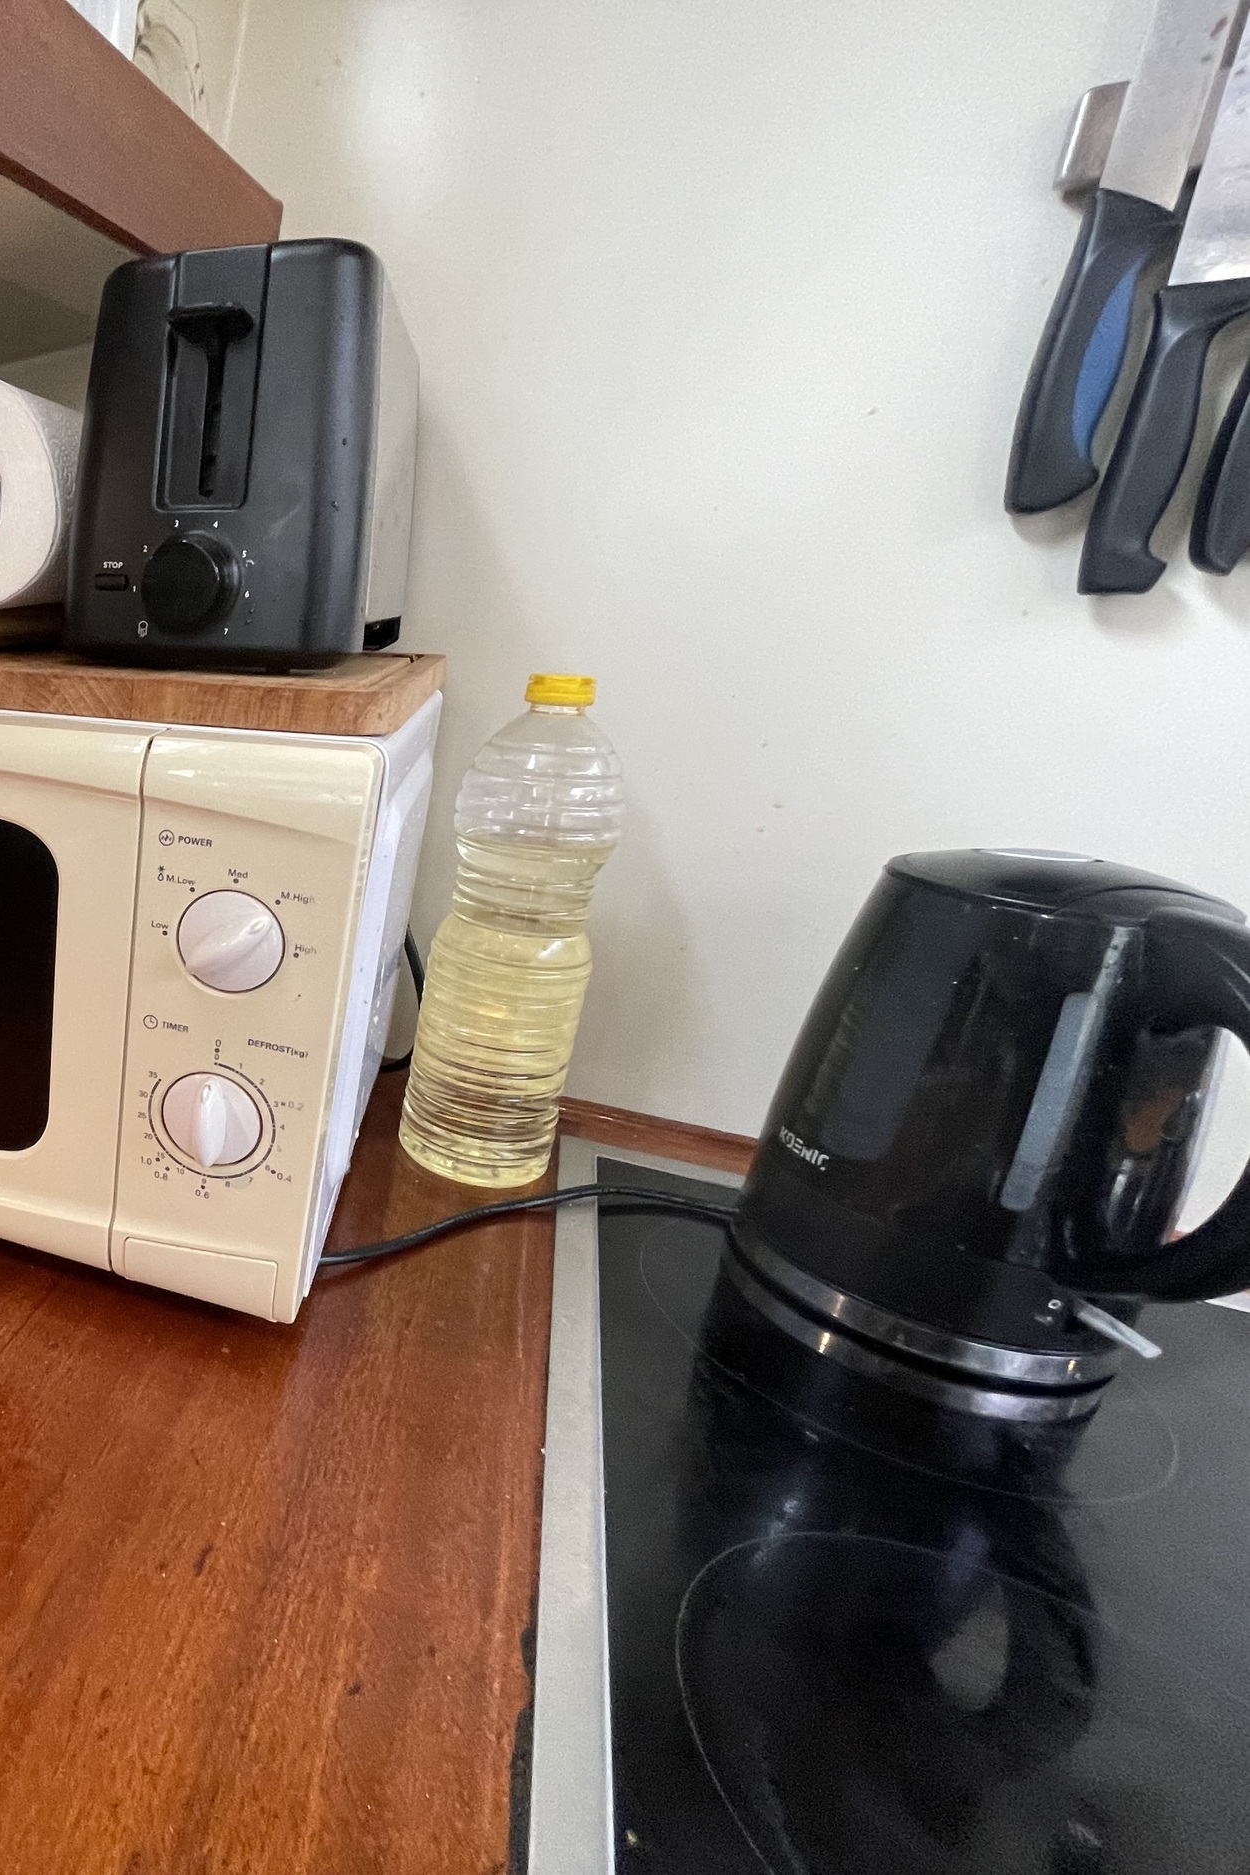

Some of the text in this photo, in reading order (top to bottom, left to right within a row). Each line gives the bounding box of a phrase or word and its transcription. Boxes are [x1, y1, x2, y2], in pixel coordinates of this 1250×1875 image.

[174, 519, 180, 528] 3
[213, 520, 219, 529] 4
[142, 545, 148, 553] 2
[241, 550, 247, 558] 5
[103, 561, 123, 569] STOP
[244, 590, 250, 599] 6
[223, 628, 229, 636] 7
[177, 835, 213, 848] POWER
[228, 868, 248, 879] Med
[166, 874, 195, 886] M.Low
[280, 891, 315, 904] M.High
[151, 920, 169, 930] Low
[294, 943, 317, 955] High
[162, 1021, 189, 1033] TIMER
[247, 1038, 309, 1059] DEFROST(kg)
[239, 1062, 243, 1070] 1
[148, 1070, 158, 1079] 35
[259, 1078, 265, 1086] 2
[138, 1090, 149, 1099] 30
[273, 1100, 279, 1108] 3
[287, 1100, 305, 1112] 0.2
[137, 1111, 147, 1119] 25
[279, 1123, 285, 1131] 4
[143, 1132, 154, 1140] 20
[156, 1151, 166, 1160] 15
[140, 1156, 153, 1166] 1.0
[176, 1167, 185, 1175] 10
[264, 1164, 271, 1172] 6
[154, 1170, 168, 1181] 0.8
[248, 1176, 254, 1184] 7
[276, 1172, 292, 1183] 0.4
[224, 1180, 231, 1188] 8
[195, 1189, 210, 1199] 0.6
